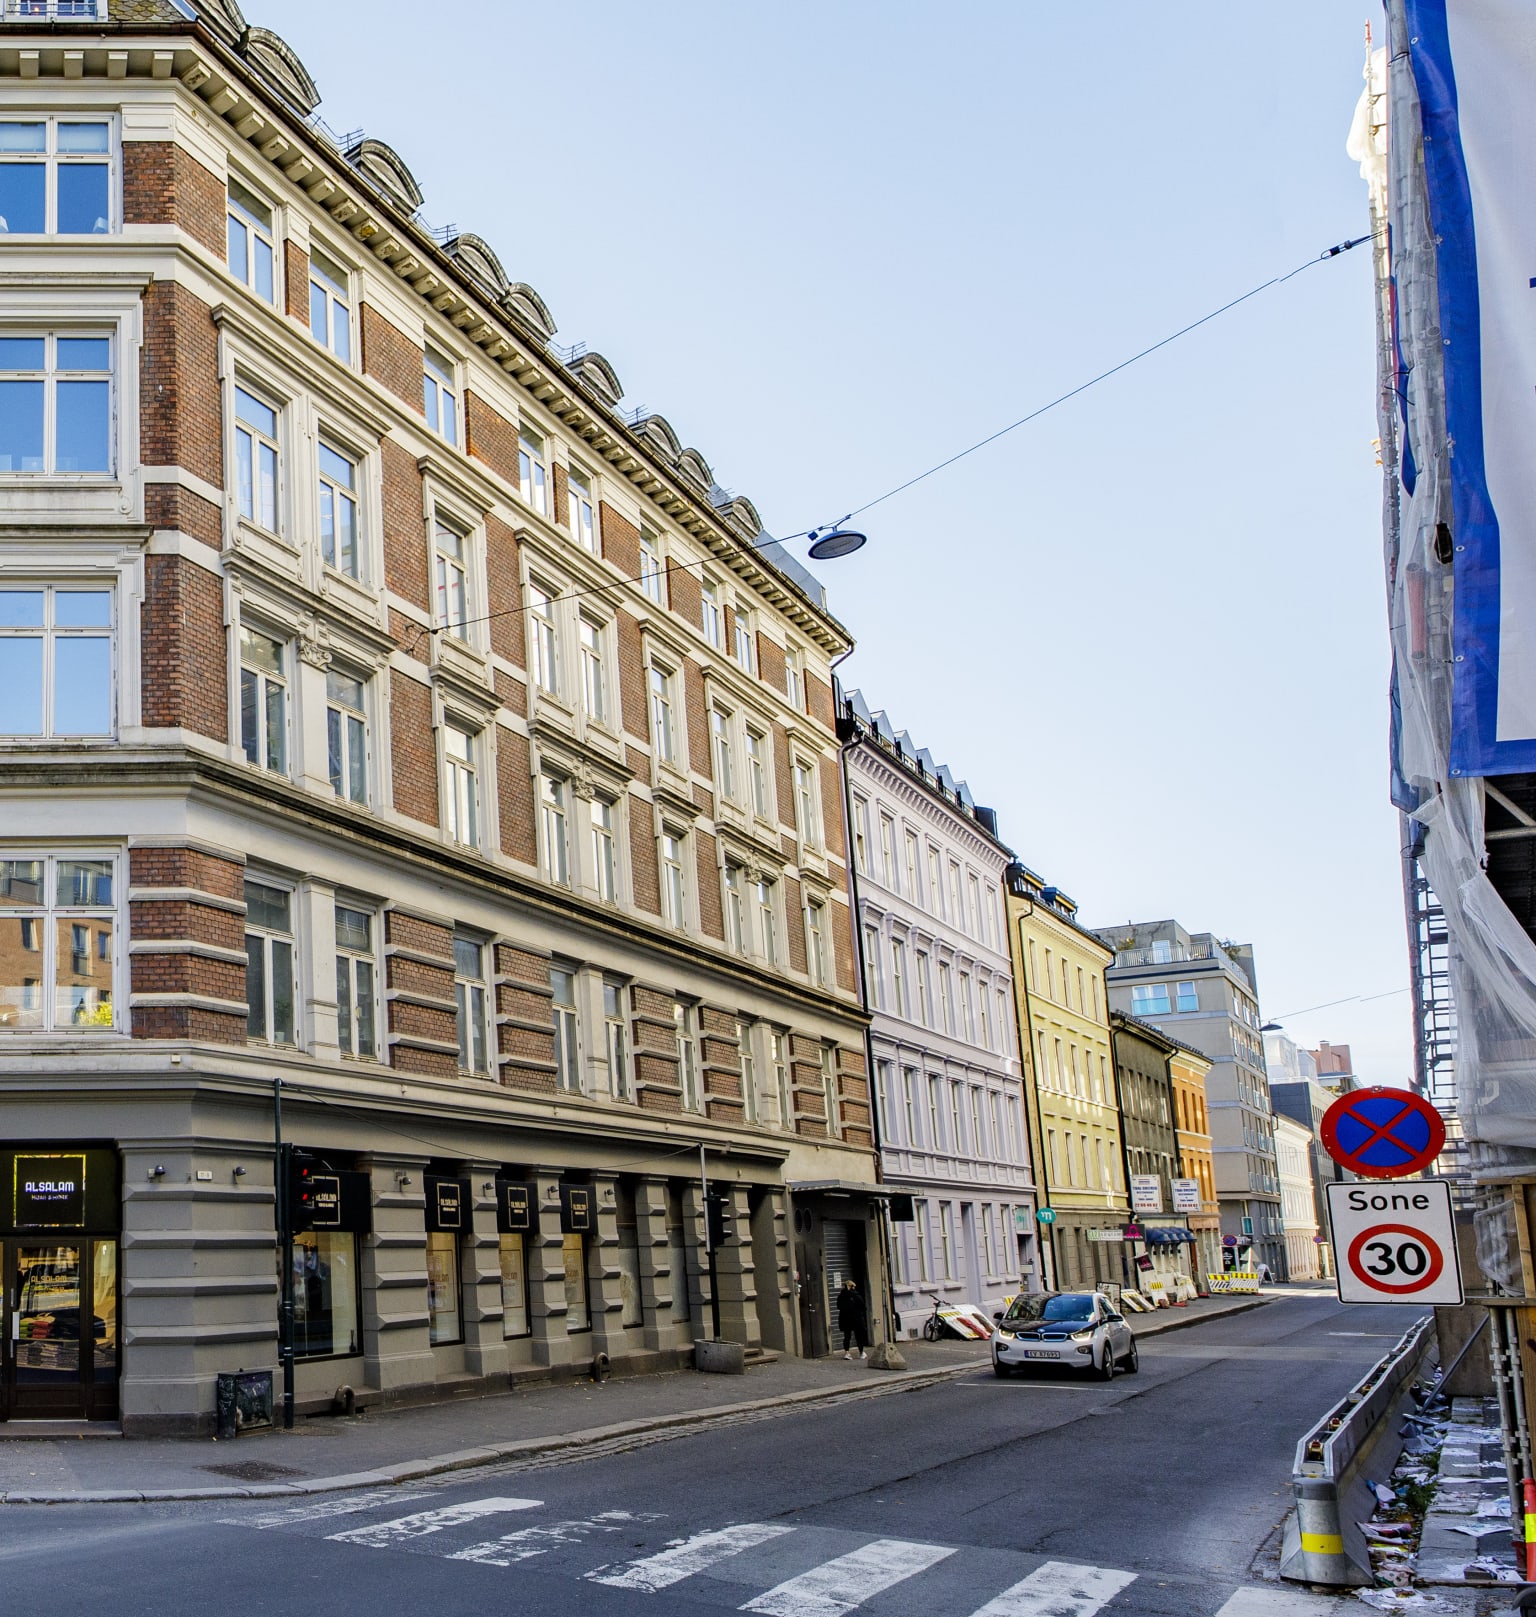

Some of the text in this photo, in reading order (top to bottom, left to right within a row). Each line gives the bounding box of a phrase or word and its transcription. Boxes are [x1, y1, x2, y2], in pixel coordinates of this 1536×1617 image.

[25, 1181, 75, 1193] ALSALAM
[1348, 1190, 1430, 1212] Sone
[1365, 1242, 1427, 1276] 30
